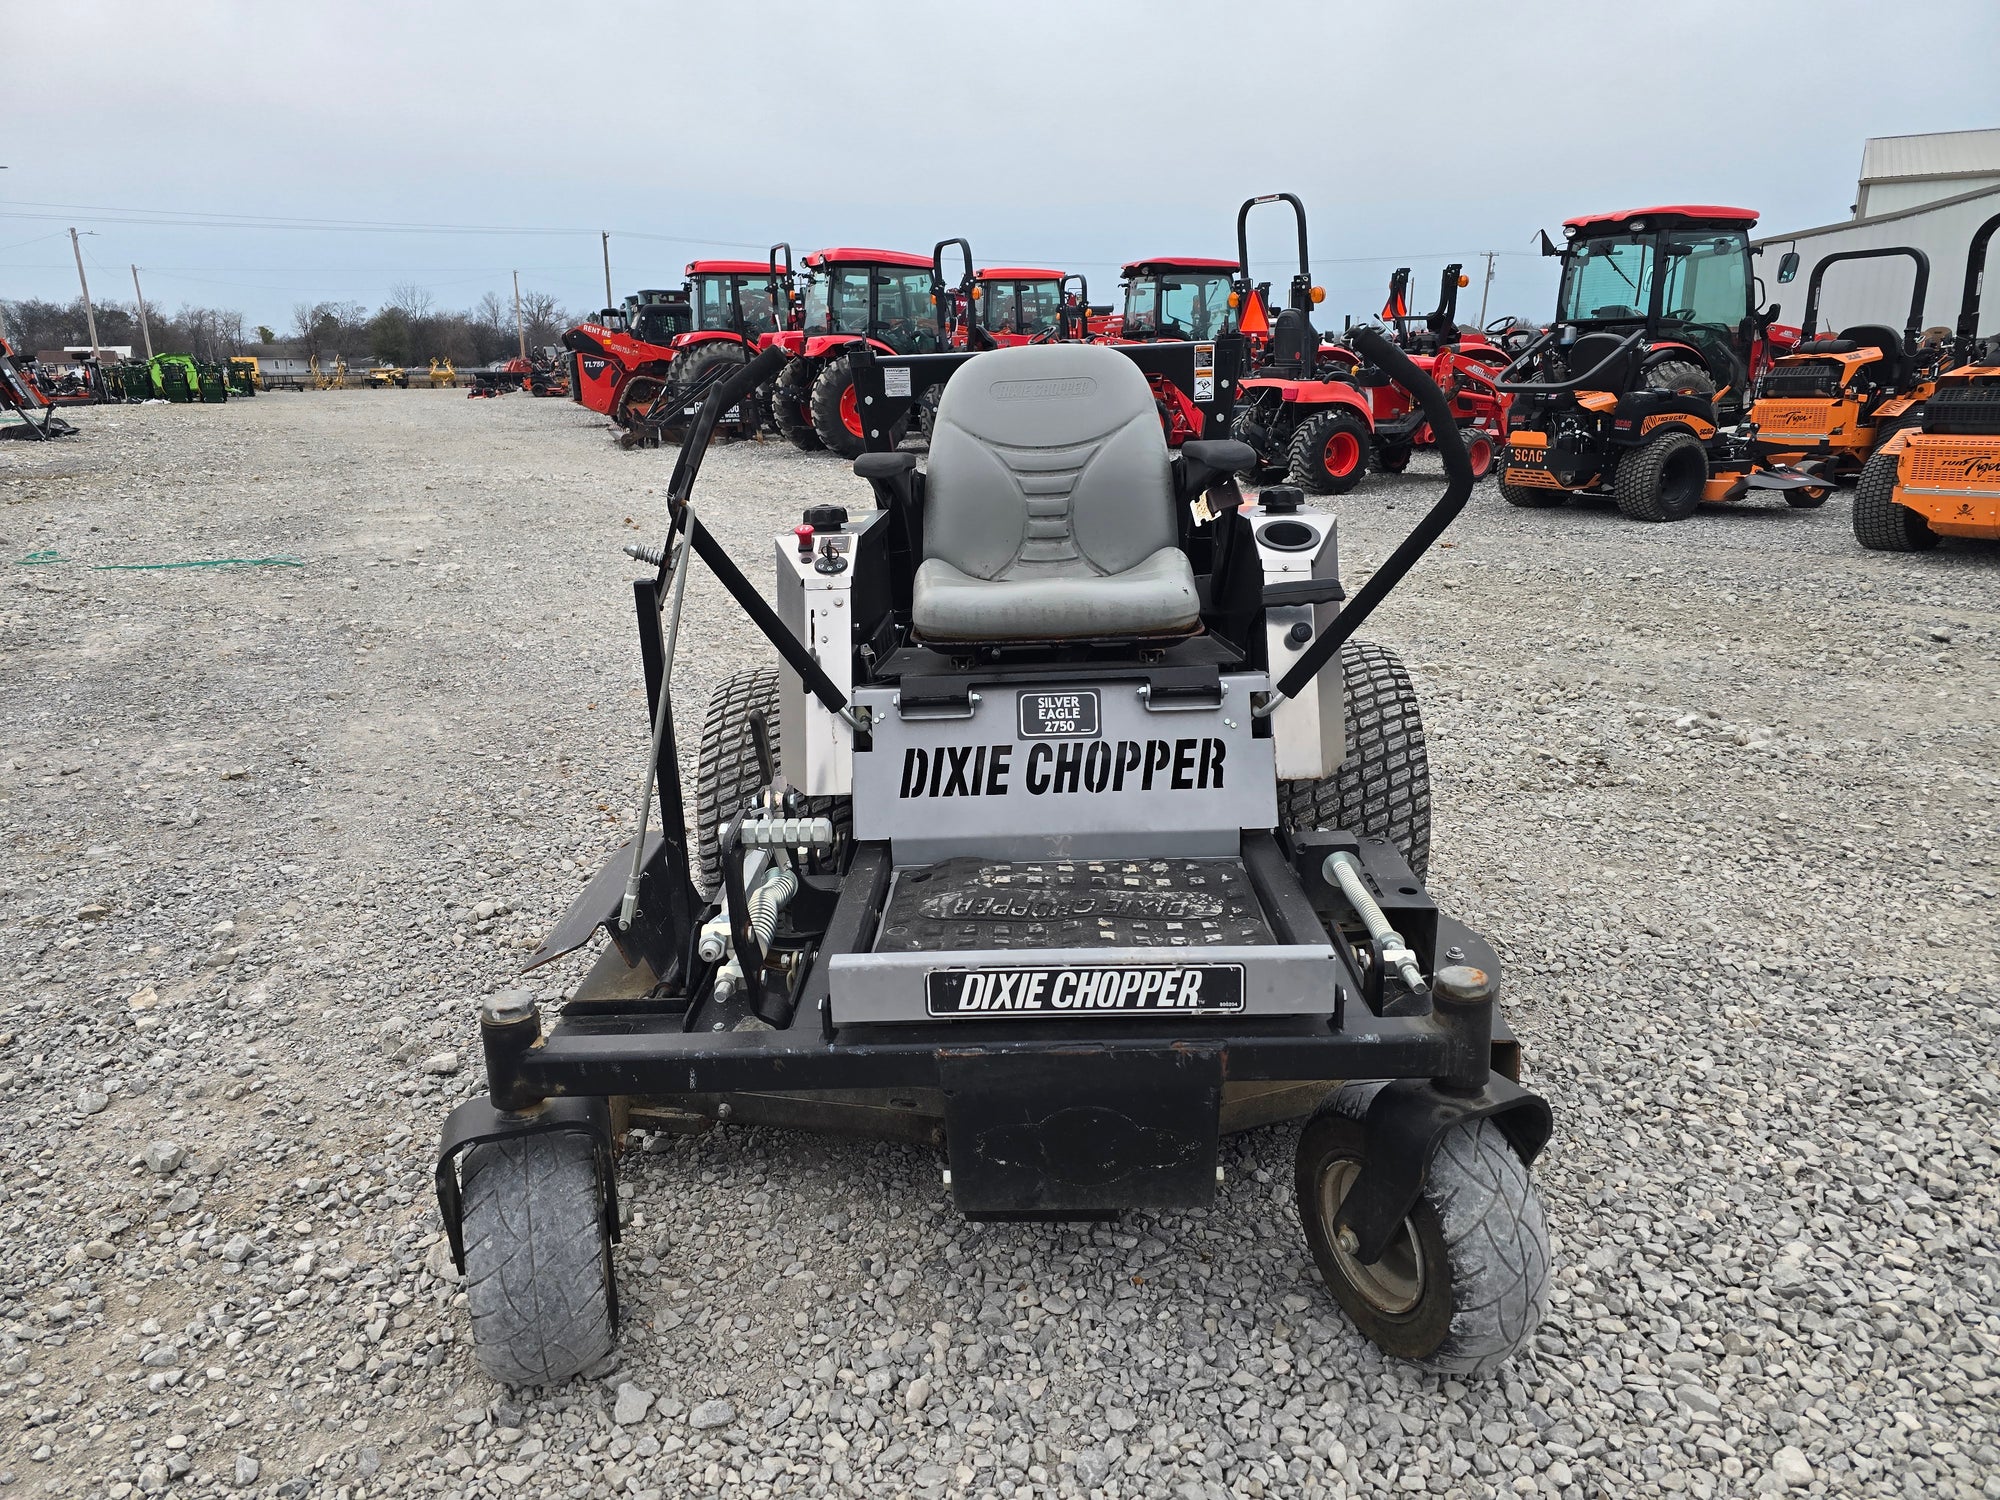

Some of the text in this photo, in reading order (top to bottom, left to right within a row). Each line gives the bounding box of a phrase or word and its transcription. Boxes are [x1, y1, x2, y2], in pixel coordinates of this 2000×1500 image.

[583, 324, 612, 338] RENT ME
[1615, 420, 1632, 428] SCAG
[1699, 428, 1714, 436] SCAG
[1514, 448, 1543, 463] SCAG
[1038, 696, 1080, 708] SILVER
[1038, 708, 1081, 720] EAGLE
[1044, 720, 1075, 732] 2750
[899, 737, 1227, 799] DIXIE CHOPPER
[958, 972, 1048, 1010] DIXIE
[1051, 970, 1203, 1009] CHOPPER
